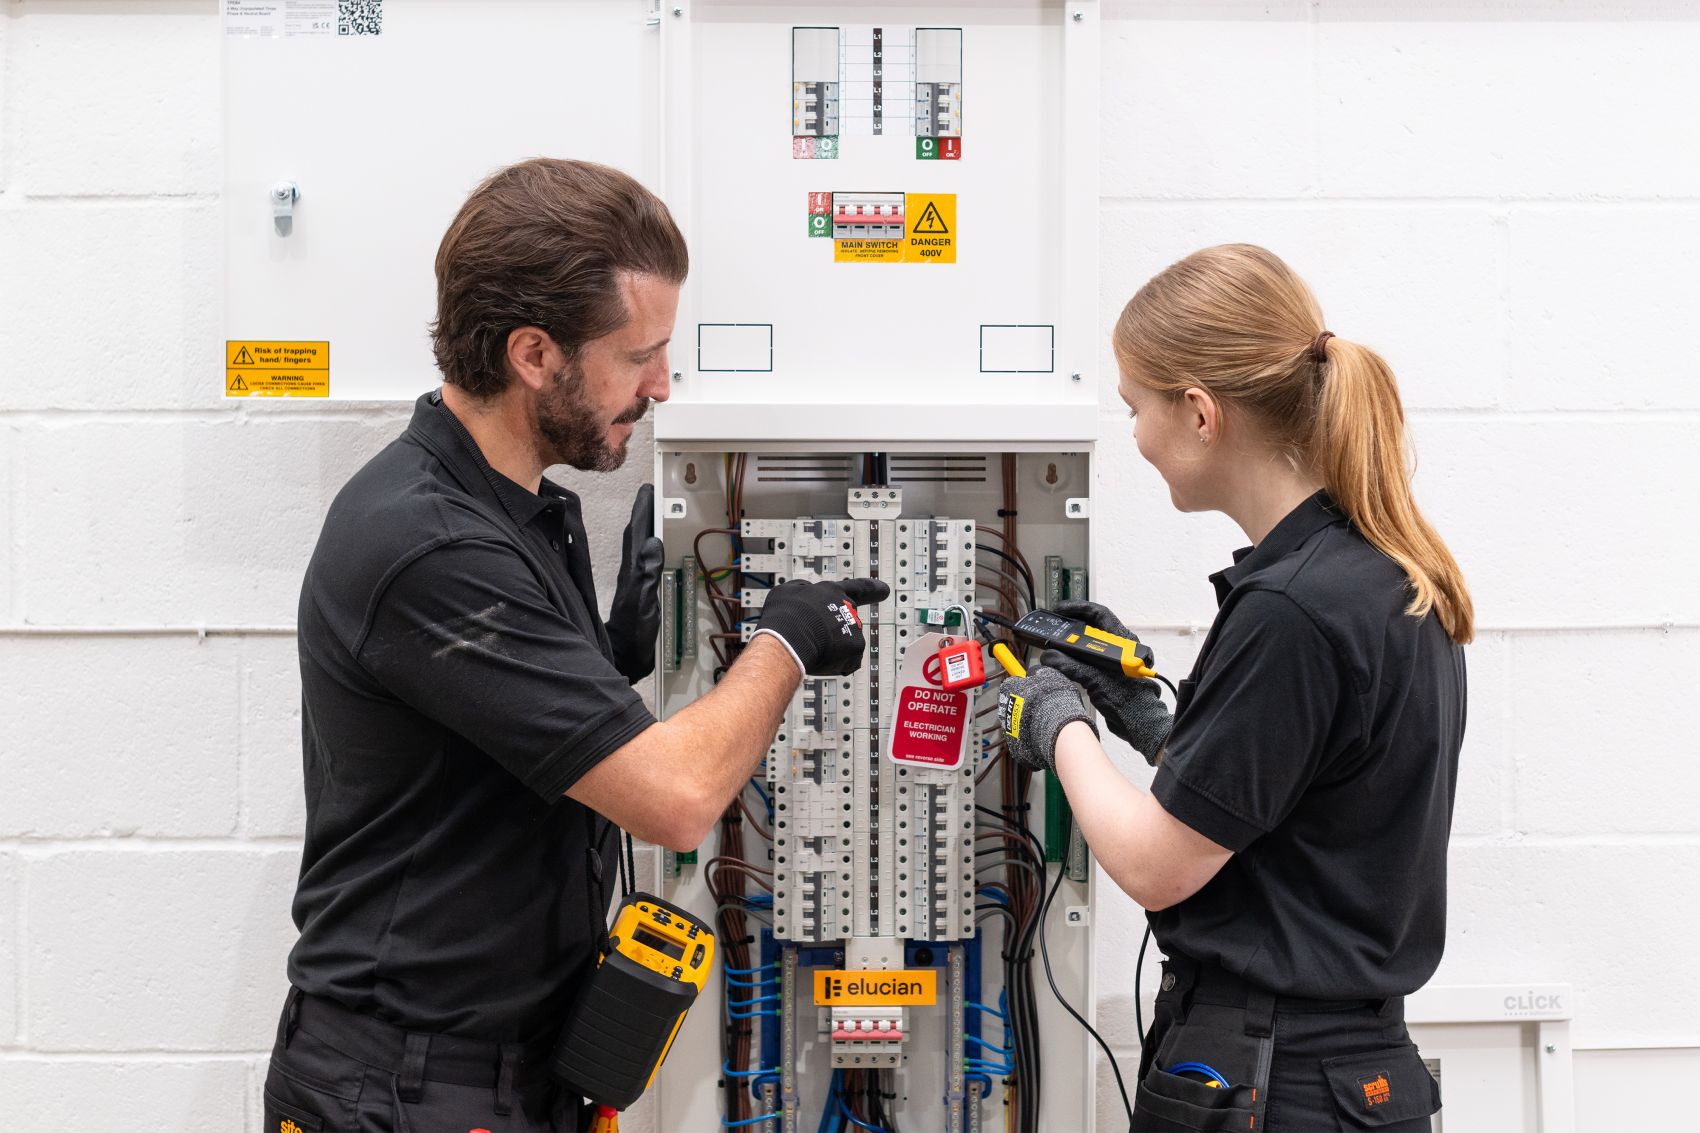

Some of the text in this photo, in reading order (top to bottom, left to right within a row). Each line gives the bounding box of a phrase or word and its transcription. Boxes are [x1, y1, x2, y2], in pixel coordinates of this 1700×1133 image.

[911, 238, 951, 246] DANGER
[915, 690, 955, 702] DO NOT
[908, 701, 957, 716] OPERATE
[904, 721, 955, 734] ELECTRICIAN
[910, 731, 947, 742] WORKING
[848, 978, 922, 995] elucian
